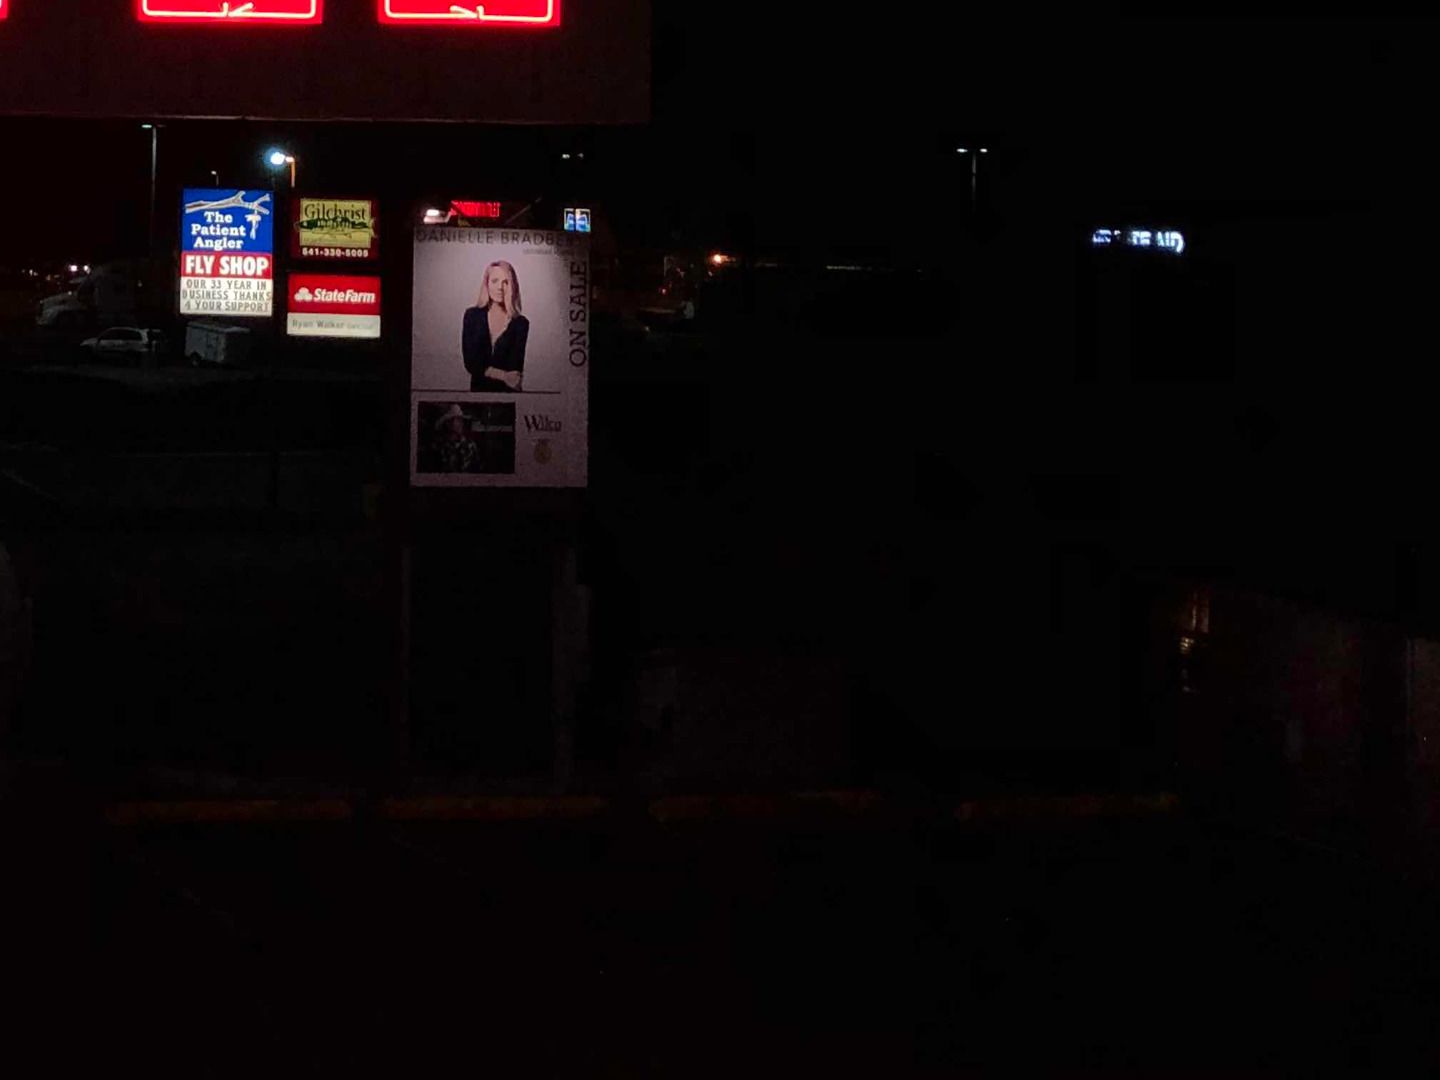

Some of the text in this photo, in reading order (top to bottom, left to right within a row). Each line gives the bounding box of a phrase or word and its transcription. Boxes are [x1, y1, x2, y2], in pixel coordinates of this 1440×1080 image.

[204, 211, 233, 223] The
[191, 224, 246, 236] Patient
[193, 237, 244, 251] Angler
[185, 255, 269, 276] FLY SHOP
[186, 280, 267, 290] OUR 33 YEAR IN
[233, 291, 272, 300] THANKS
[195, 300, 222, 310] YOUR
[225, 302, 269, 312] SUPPORT
[569, 261, 587, 367] ON SALE
